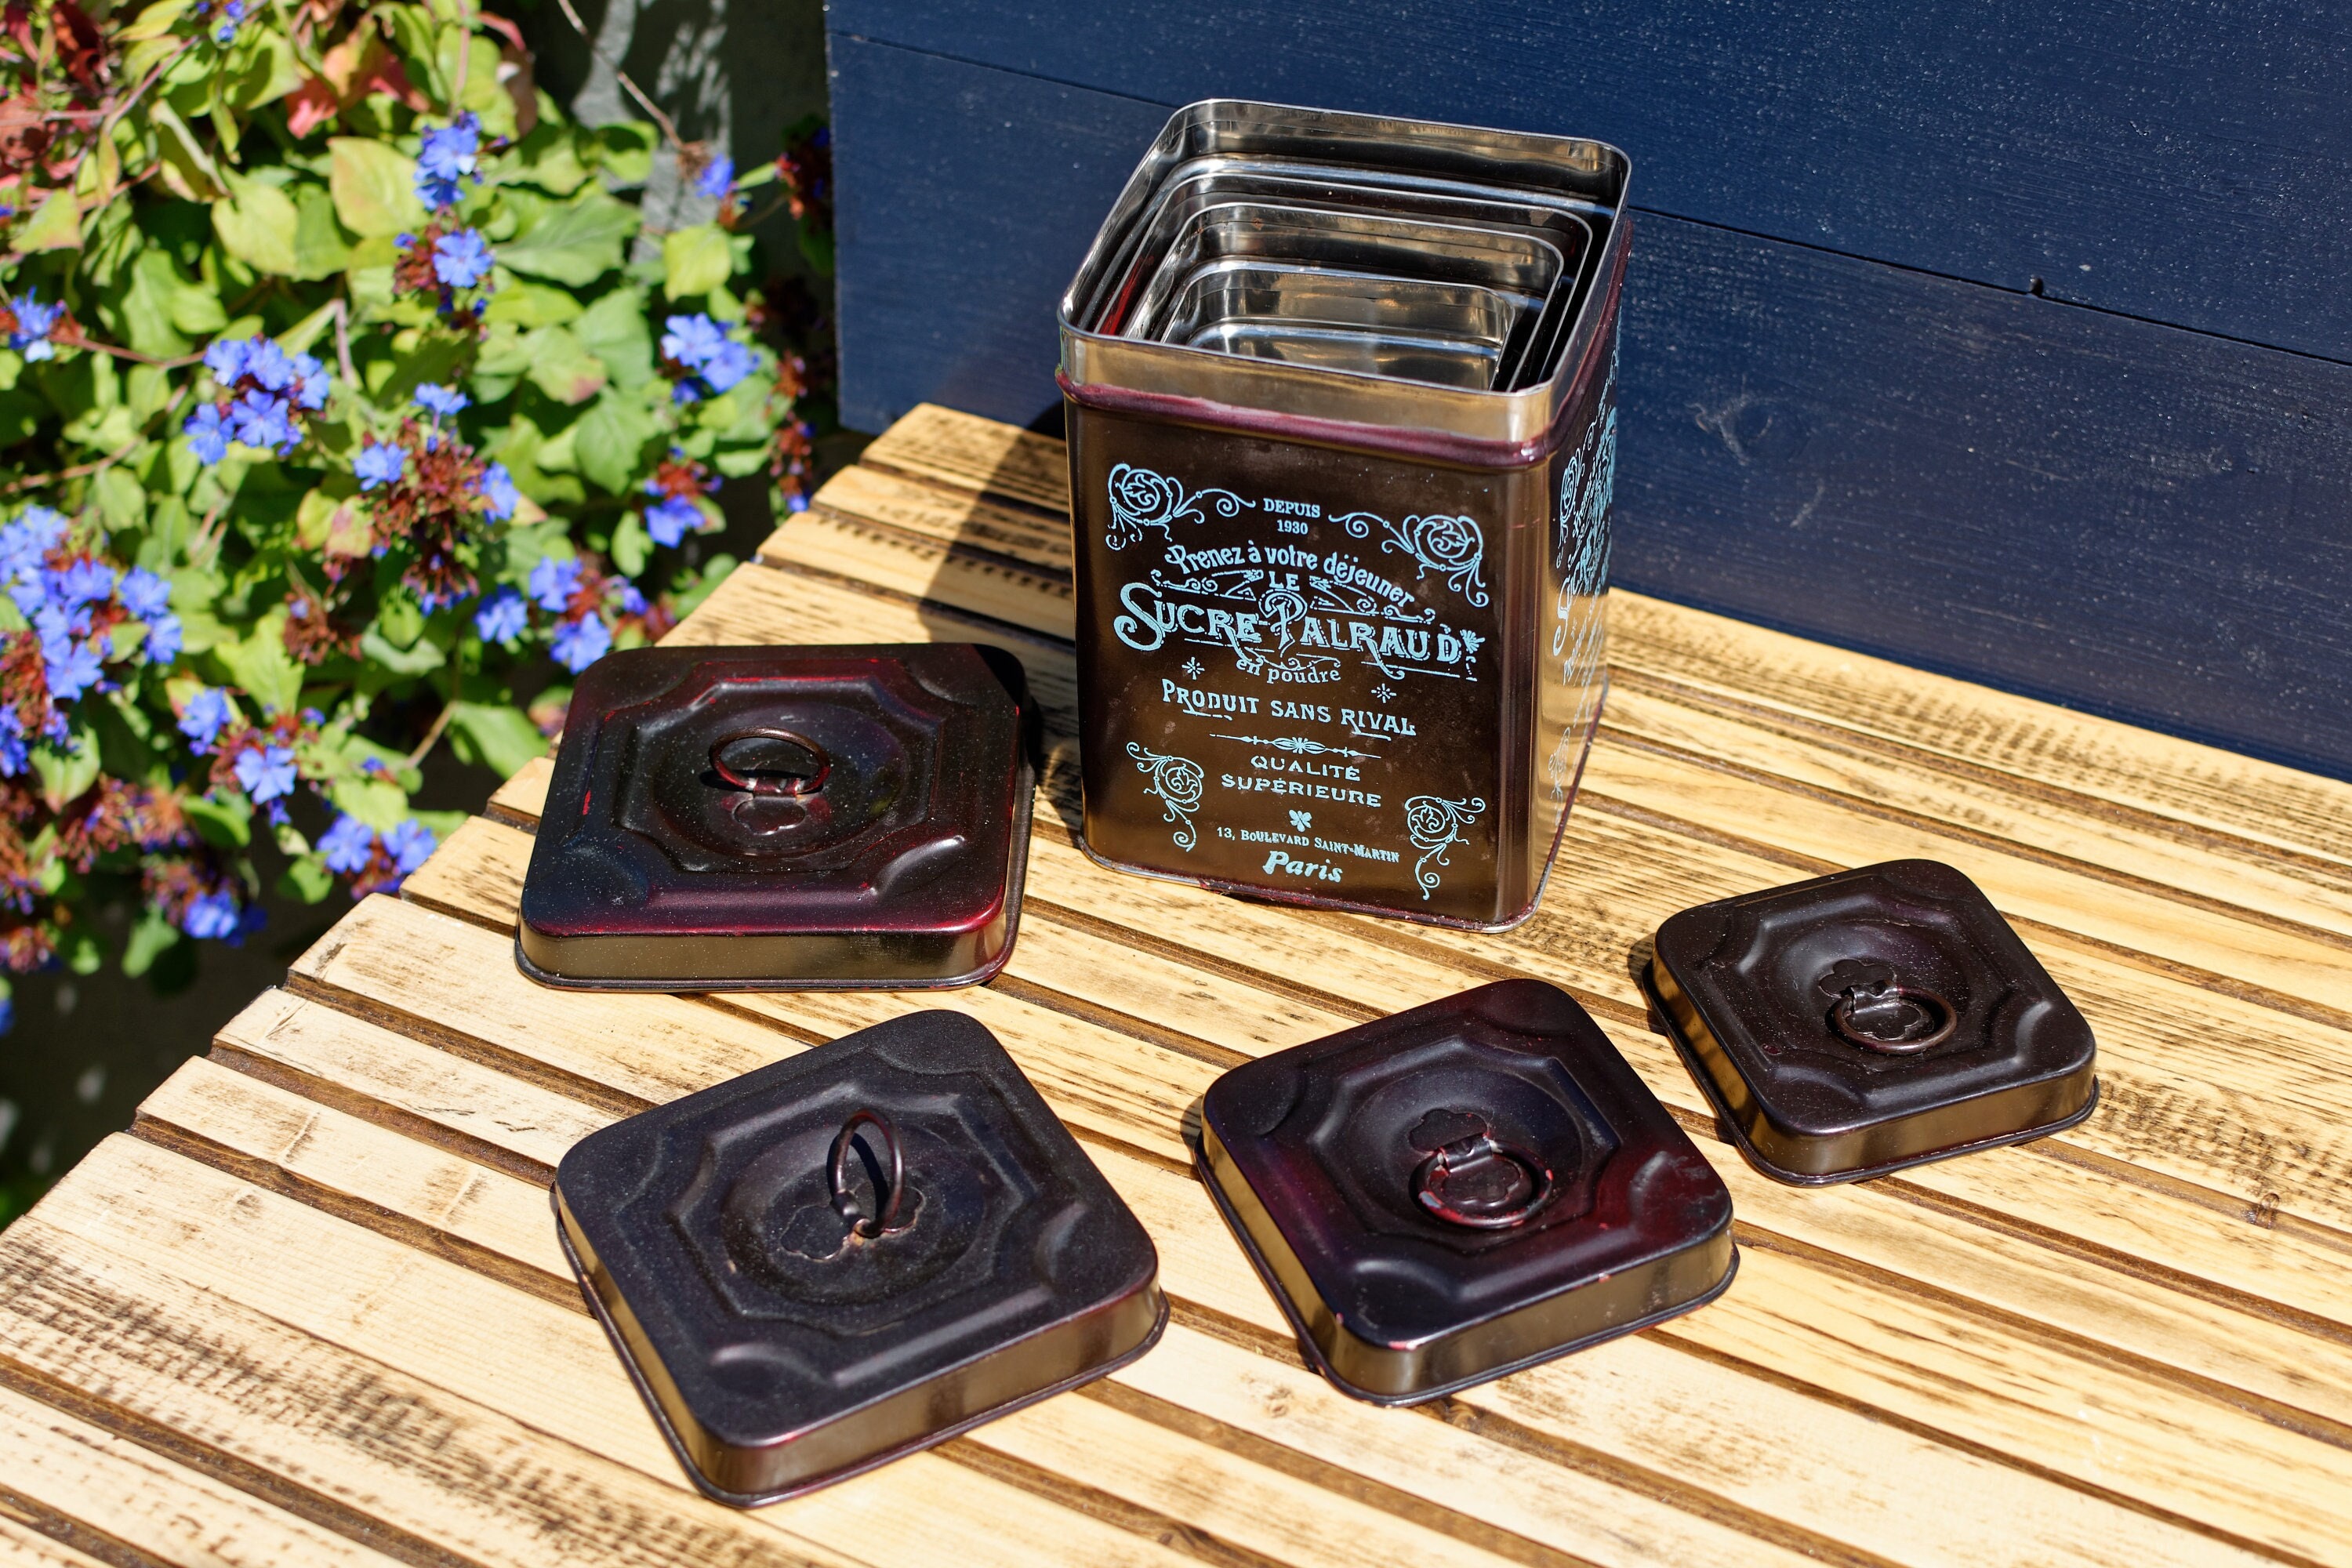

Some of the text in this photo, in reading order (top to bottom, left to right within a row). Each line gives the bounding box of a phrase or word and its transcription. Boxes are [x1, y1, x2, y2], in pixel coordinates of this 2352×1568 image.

[1263, 497, 1321, 518] DEPUIS
[1276, 519, 1308, 535] 1930
[1164, 544, 1246, 575] Prenez
[1247, 539, 1262, 564] à
[1264, 544, 1318, 571] votre
[1268, 570, 1301, 591] LE
[1236, 657, 1341, 684] en poudre
[1161, 678, 1417, 741] PRODUIT SANS RIVAL
[1250, 755, 1360, 782] QUALITÉ
[1221, 773, 1381, 808] SUPÉRIEURE
[1216, 827, 1400, 863] 13, BOULEVARD SAINT-MARTIN
[1262, 850, 1344, 883] Paris
